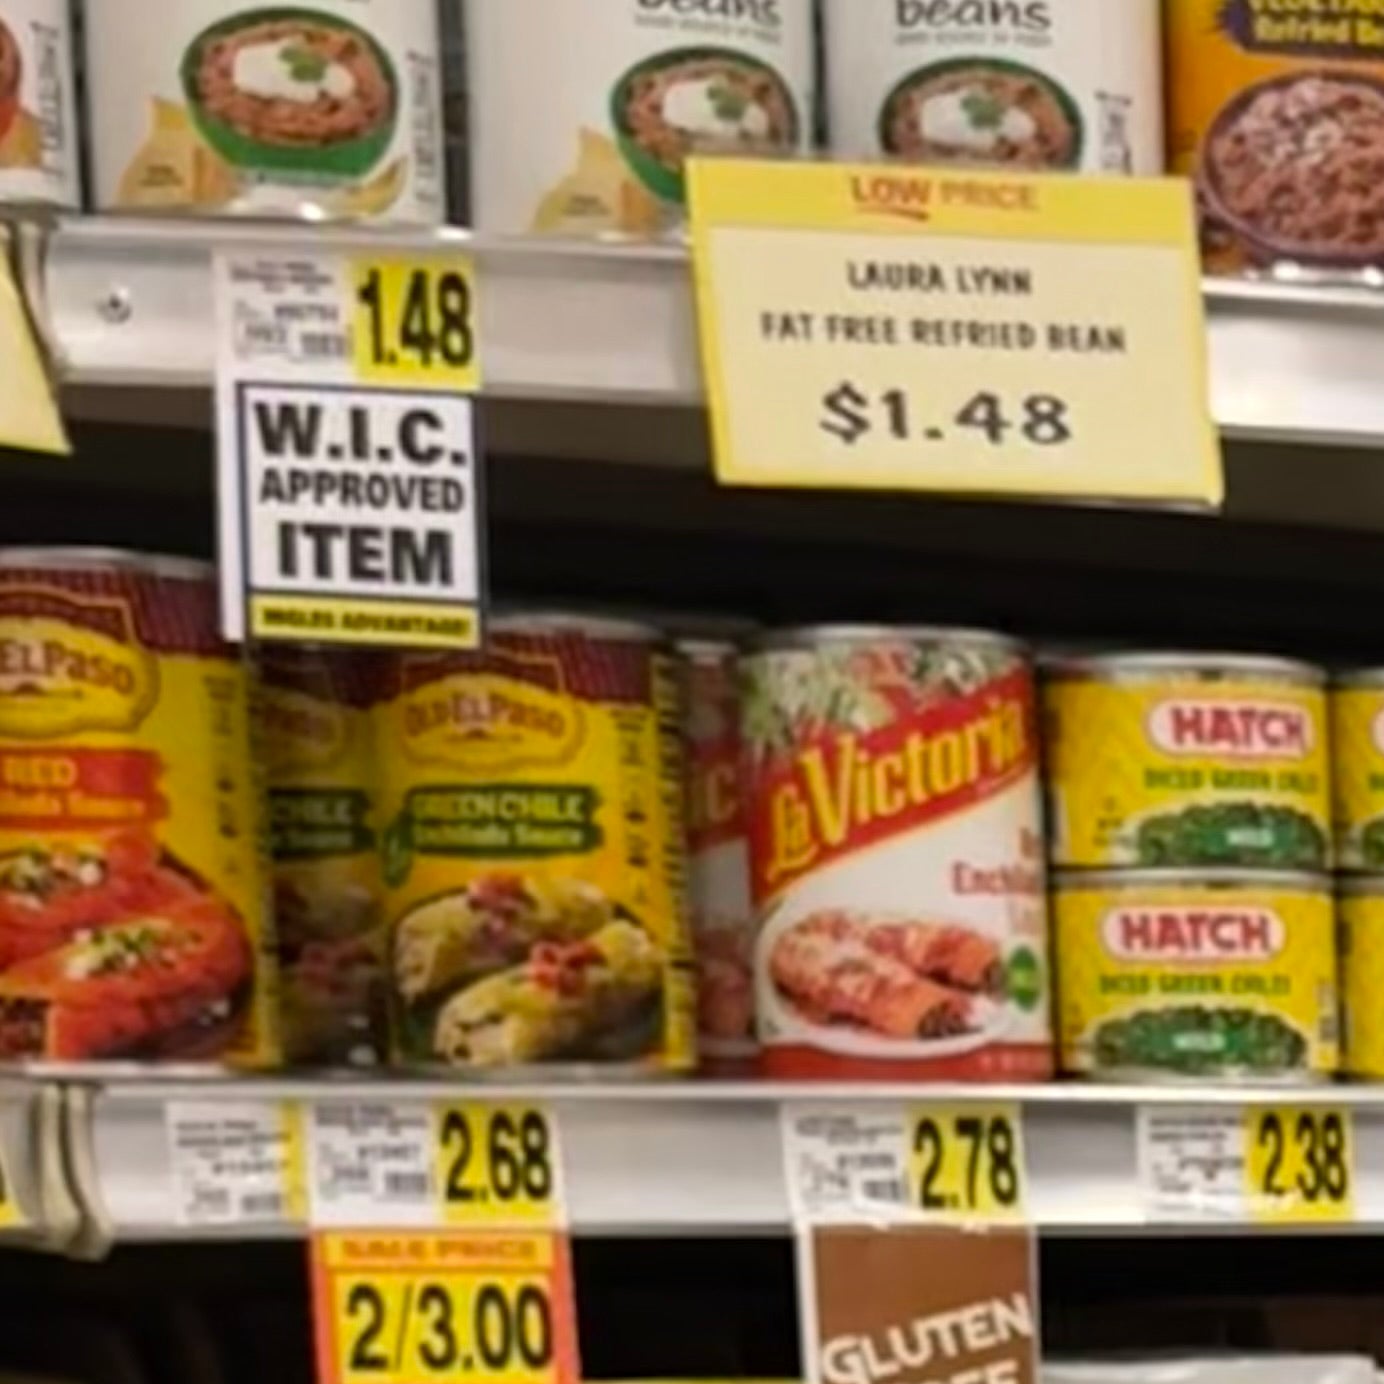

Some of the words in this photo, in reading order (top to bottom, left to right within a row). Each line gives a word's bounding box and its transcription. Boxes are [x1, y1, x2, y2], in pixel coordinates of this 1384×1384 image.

[851, 176, 931, 205] LOW
[846, 261, 944, 293] LAURA
[956, 265, 1031, 295] LYNN
[357, 267, 473, 367] 1.48
[761, 312, 814, 341] FAT
[826, 315, 896, 344] FREE
[911, 318, 1037, 350] REFRIED
[1046, 322, 1127, 352] BEAN
[253, 400, 468, 466] W.I.C.
[820, 380, 1072, 445] $1.48
[259, 467, 465, 513] APPROVED
[278, 522, 453, 588] ITEM
[1170, 706, 1305, 752] HATCH
[800, 695, 1027, 846] Victoria
[1120, 913, 1271, 953] HATCH
[440, 1109, 552, 1203] 2.68
[915, 1117, 1019, 1213] 2.78
[1257, 1111, 1347, 1202] 2.38
[346, 1285, 553, 1371] 2/3.00
